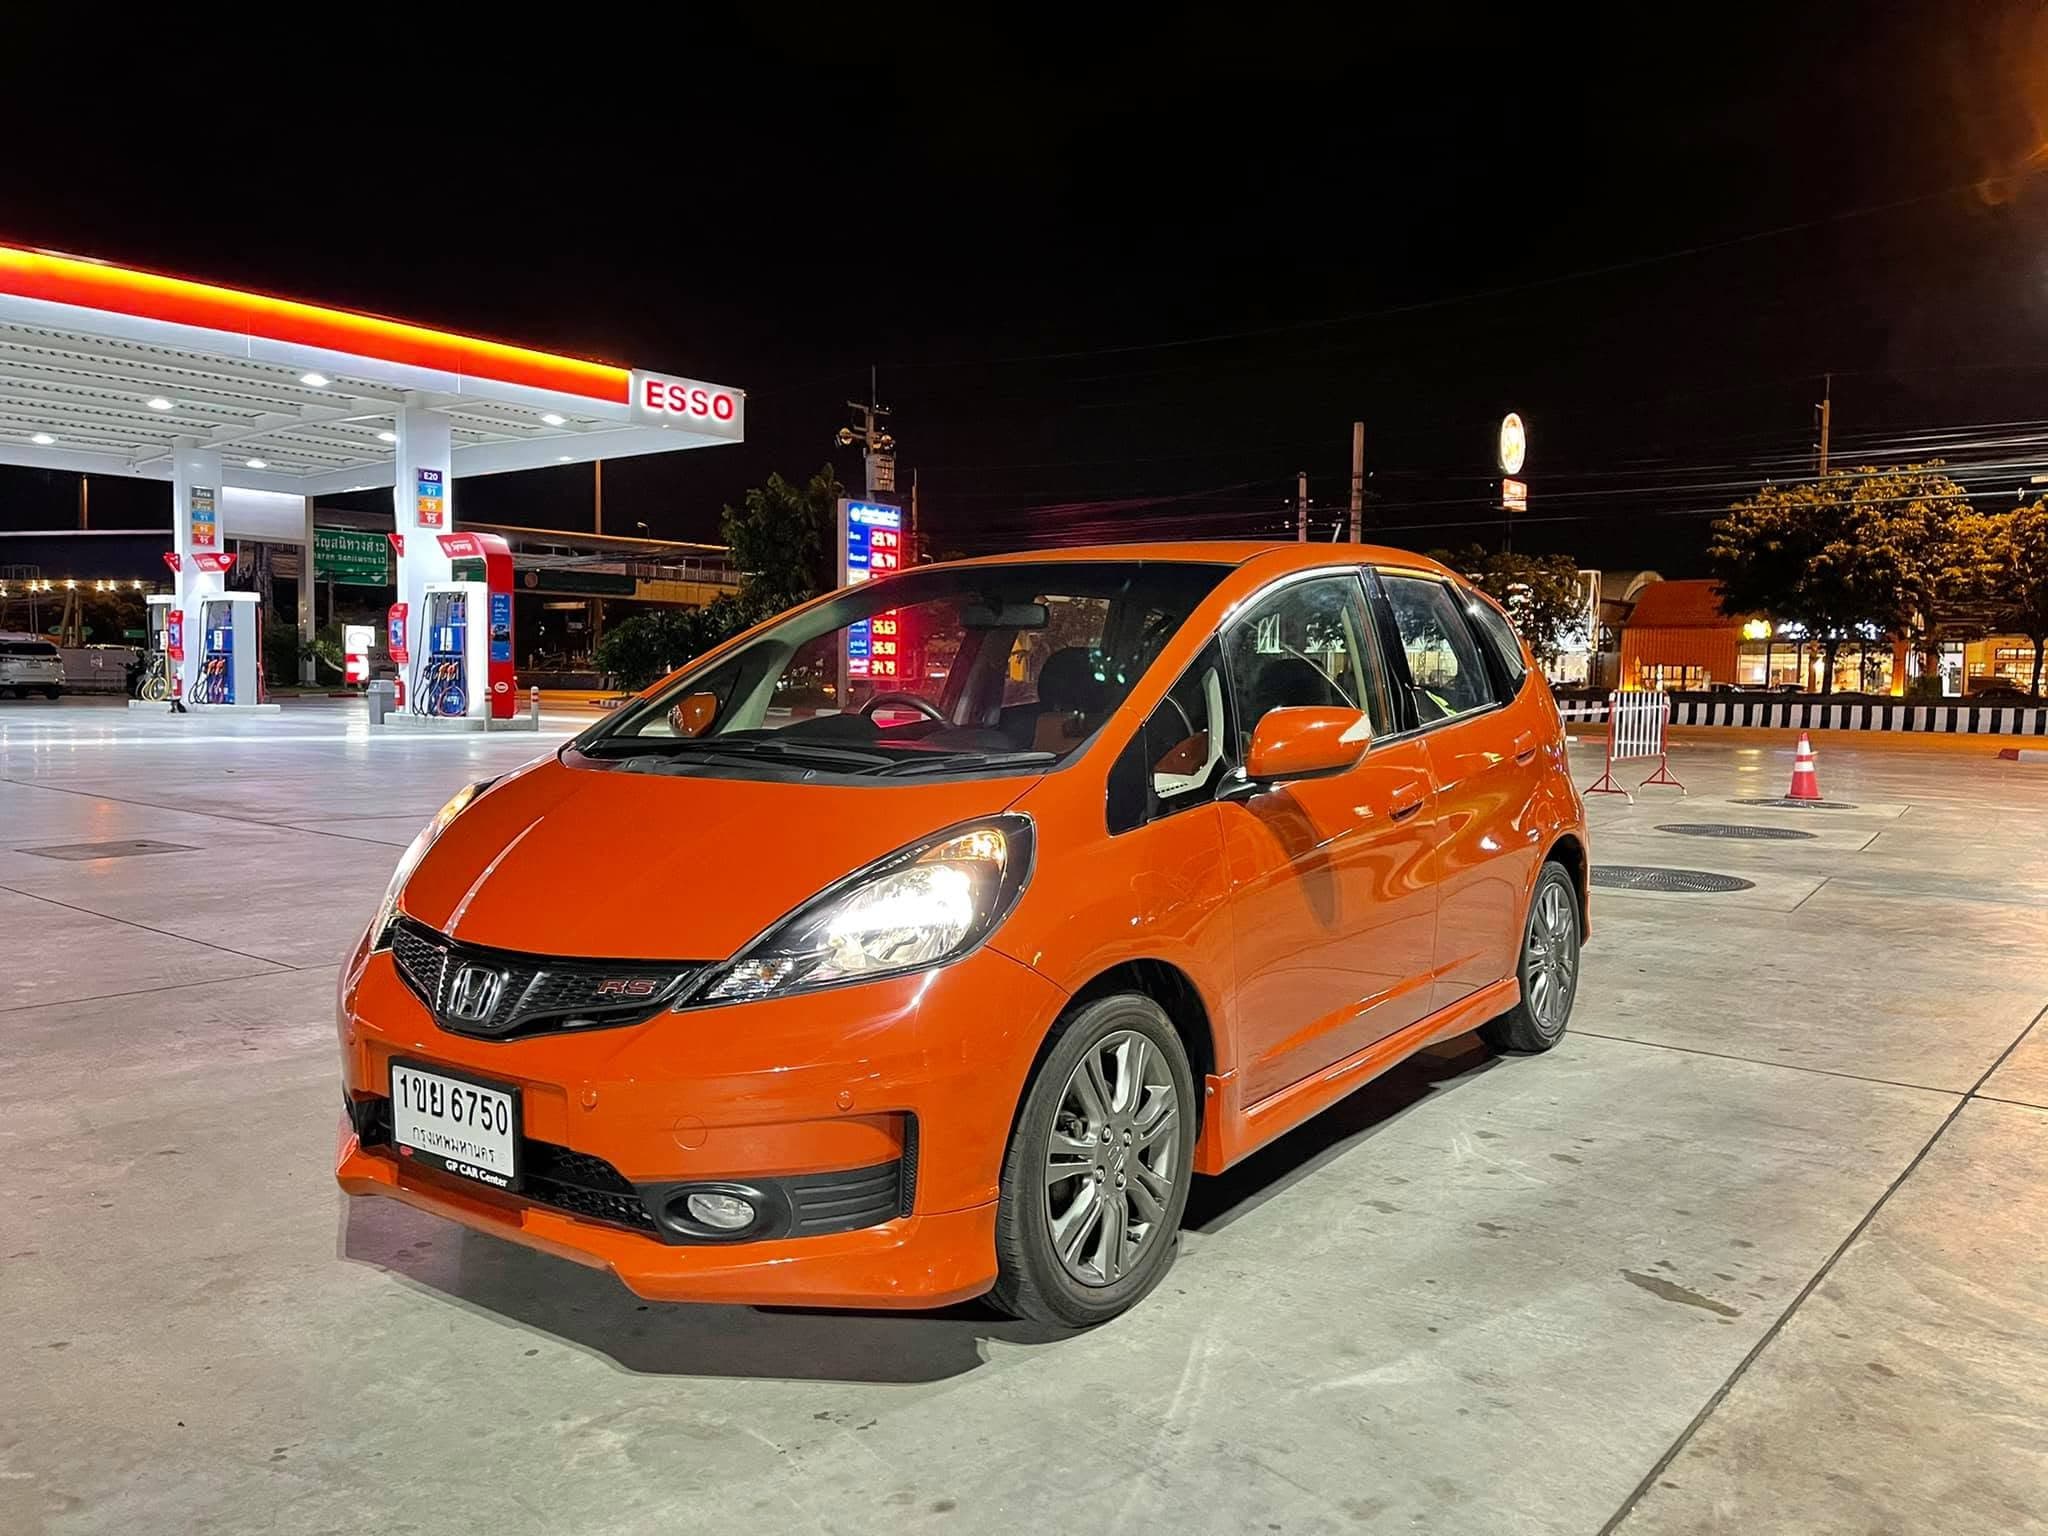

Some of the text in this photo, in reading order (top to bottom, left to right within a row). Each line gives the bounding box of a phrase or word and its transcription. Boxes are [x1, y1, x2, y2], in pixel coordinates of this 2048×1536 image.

[646, 379, 734, 421] ESSO
[424, 472, 438, 480] E20
[314, 534, 386, 553] รัญสนิทวงศ์ 13
[596, 979, 657, 996] RS
[400, 1074, 508, 1136] 1ขย 6750
[412, 1126, 495, 1163] กรุงเทพมหานคร
[445, 1160, 508, 1188] GP CAR Center
